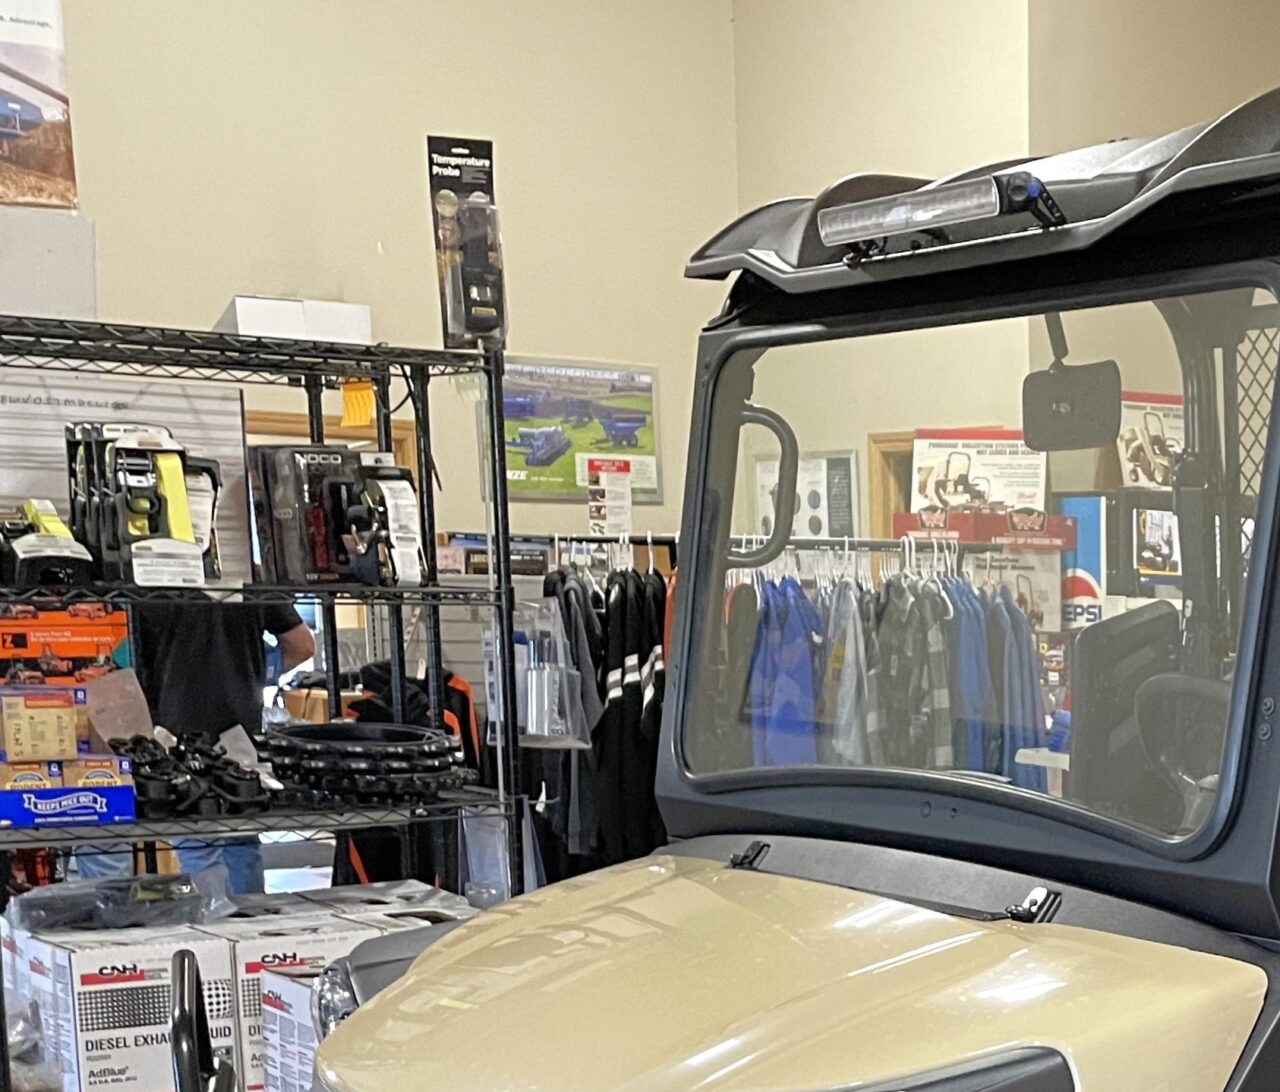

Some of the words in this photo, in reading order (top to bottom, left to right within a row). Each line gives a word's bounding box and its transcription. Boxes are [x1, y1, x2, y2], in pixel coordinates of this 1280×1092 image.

[431, 153, 491, 168] Temperature
[432, 165, 461, 177] Probe
[506, 470, 528, 480] NZE
[1062, 604, 1103, 624] EPSI
[37, 801, 60, 811] KEEPS
[61, 797, 77, 807] MICE
[78, 795, 94, 804] OUT
[261, 952, 297, 964] CNH
[98, 963, 138, 977] CNH
[85, 1035, 131, 1053] DIESEL
[134, 1032, 172, 1049] EXHA
[210, 1026, 232, 1040] UID
